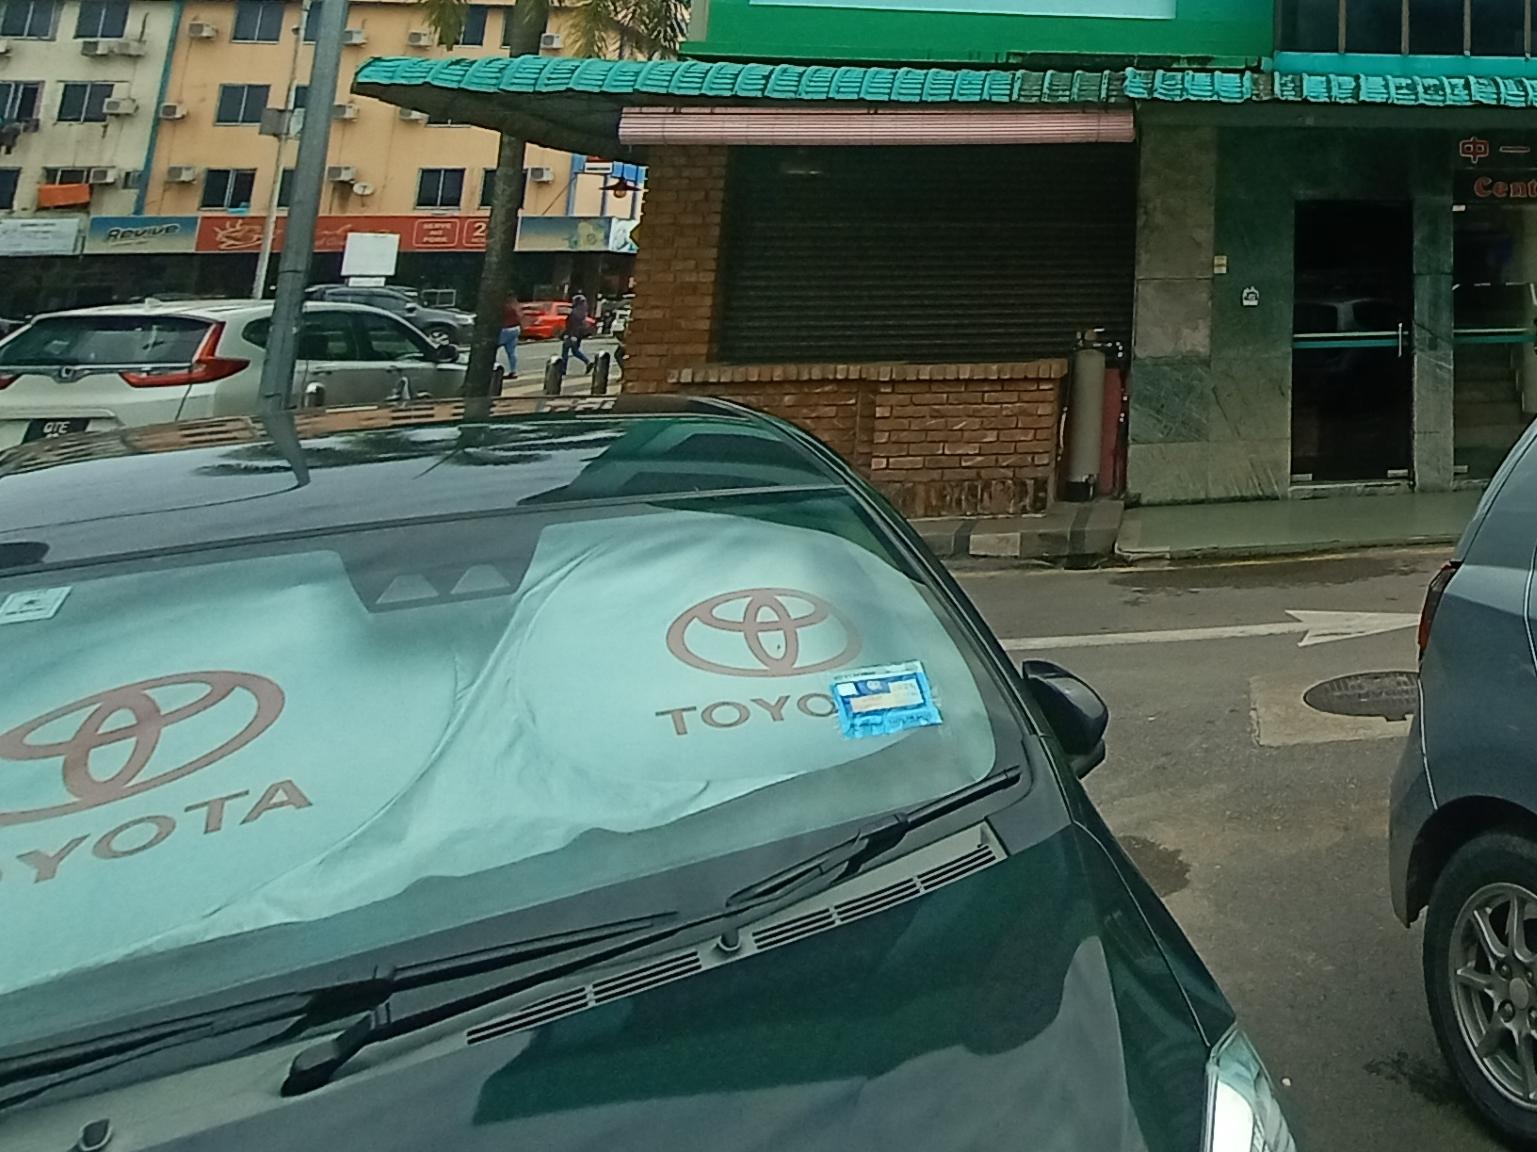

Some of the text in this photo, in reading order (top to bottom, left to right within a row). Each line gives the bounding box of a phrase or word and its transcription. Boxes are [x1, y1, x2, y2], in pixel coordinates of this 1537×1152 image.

[473, 222, 487, 236] 2
[655, 693, 838, 736] TOYO
[0, 779, 313, 884] YOTA
